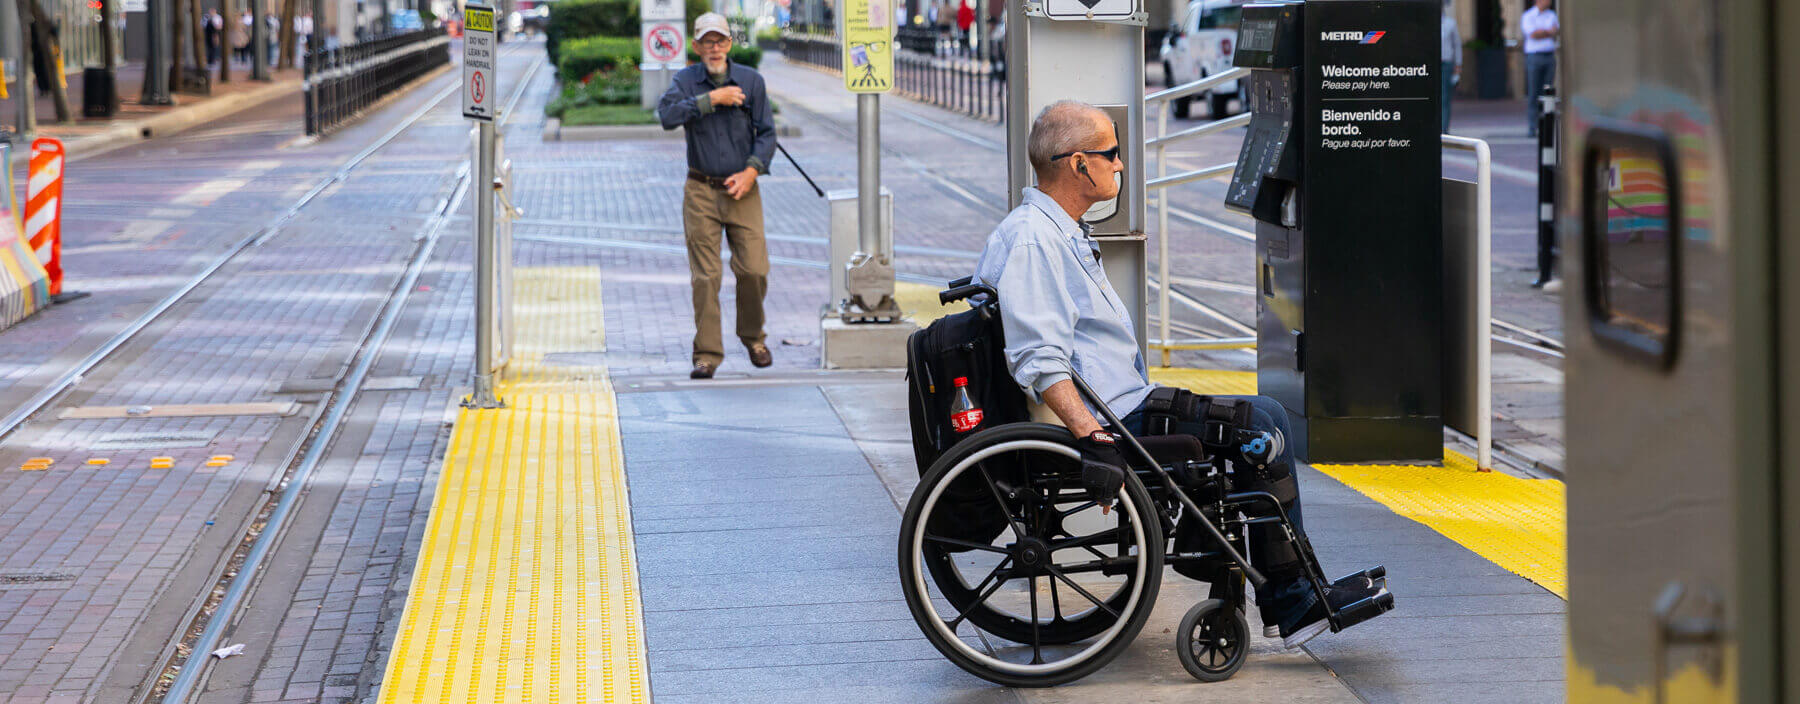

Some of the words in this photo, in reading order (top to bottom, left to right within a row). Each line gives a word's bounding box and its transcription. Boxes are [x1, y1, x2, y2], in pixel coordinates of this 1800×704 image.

[472, 13, 493, 28] CAUTION
[1321, 31, 1363, 40] METRO
[469, 37, 477, 45] DO
[477, 37, 488, 46] NOT
[468, 47, 481, 56] LEAN
[466, 59, 490, 70] HANDRAIL
[1321, 65, 1380, 76] Welcome
[1382, 64, 1429, 76] aboard.
[1321, 80, 1351, 89] Please
[1351, 82, 1368, 92] pay
[1369, 80, 1391, 89] here.
[1321, 109, 1391, 121] Bienvenido
[1392, 111, 1401, 121] a
[1321, 123, 1362, 135] bordo.
[1321, 138, 1350, 149] Pague
[1371, 140, 1387, 149] por
[1387, 138, 1411, 148] favor.
